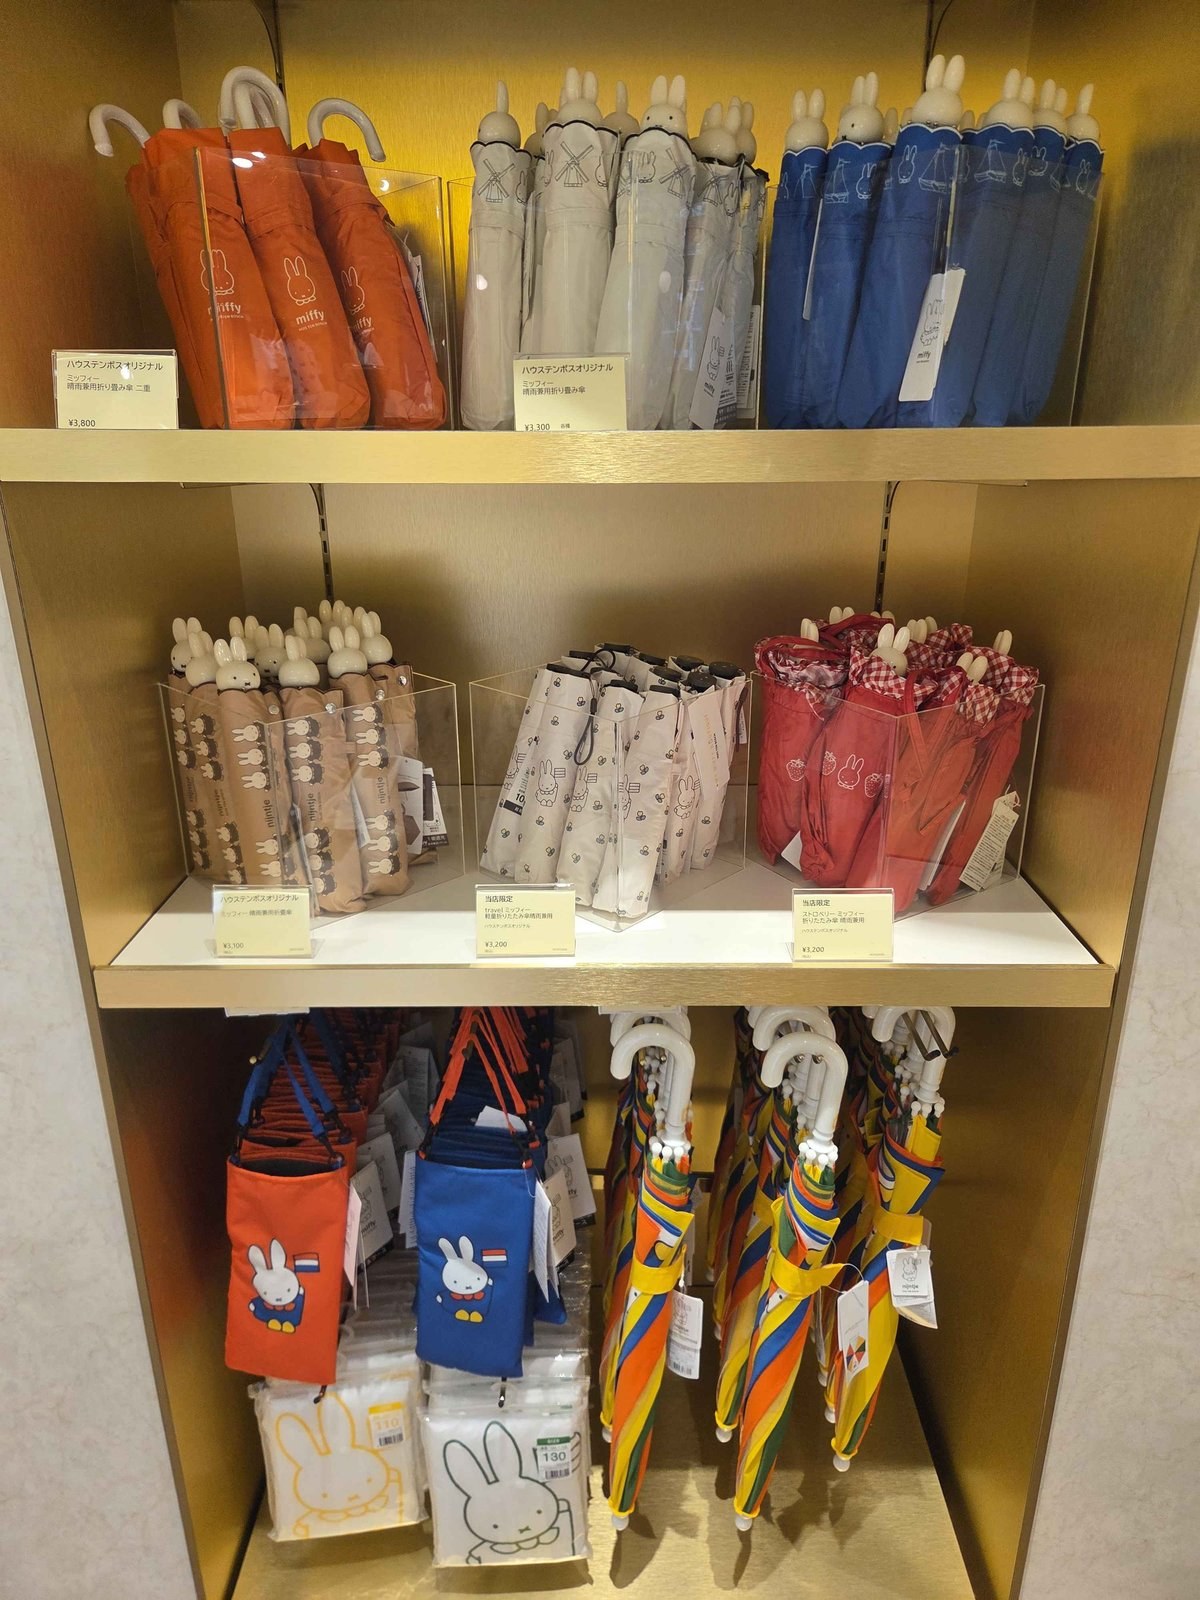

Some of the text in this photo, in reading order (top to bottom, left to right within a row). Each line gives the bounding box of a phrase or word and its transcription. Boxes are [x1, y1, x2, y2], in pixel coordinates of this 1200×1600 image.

[296, 309, 325, 325] miffy
[67, 360, 163, 371] ハウステンボスオリジナル
[522, 363, 613, 374] ハウステンボスオリジナル
[67, 374, 100, 382] ミッフィー
[68, 419, 96, 427] ¥3,800
[376, 776, 387, 804] nijntje
[306, 793, 318, 821] nijntje
[262, 799, 275, 828] nijntje
[485, 895, 513, 903] 当店限定
[223, 942, 244, 950] ¥3,100
[542, 1451, 567, 1462] 130
